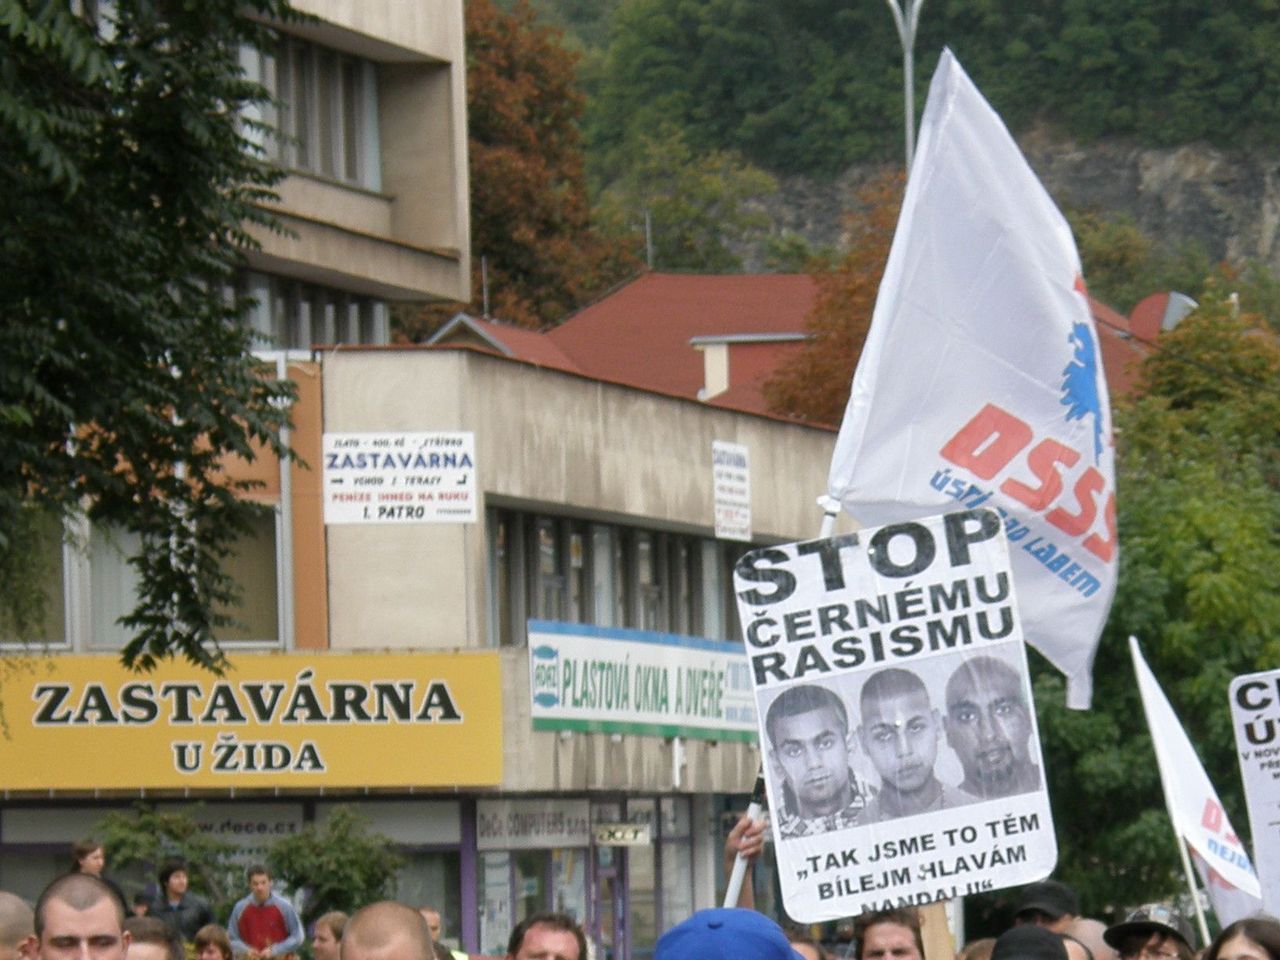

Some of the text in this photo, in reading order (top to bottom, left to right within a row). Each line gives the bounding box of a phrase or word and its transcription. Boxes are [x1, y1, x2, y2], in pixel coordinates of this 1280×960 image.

[325, 448, 473, 469] ZASTAVÁRNA
[378, 505, 425, 520] PATRO
[418, 492, 433, 502] NA
[735, 507, 1001, 606] STOP
[747, 572, 1011, 650] ČERNÉMU
[752, 606, 1015, 685] RASISMU
[33, 669, 463, 726] ZASTAVÁRNA
[561, 653, 630, 711] PLASTOVÁ
[634, 662, 670, 714] OKNA
[685, 660, 724, 719] DVEŘE
[172, 733, 327, 773] U ŽIDA
[868, 833, 936, 863] JSME
[943, 825, 978, 847] TO
[986, 812, 1041, 838] TĚM
[817, 844, 1027, 901] BÍLEJM HLAVÁM
